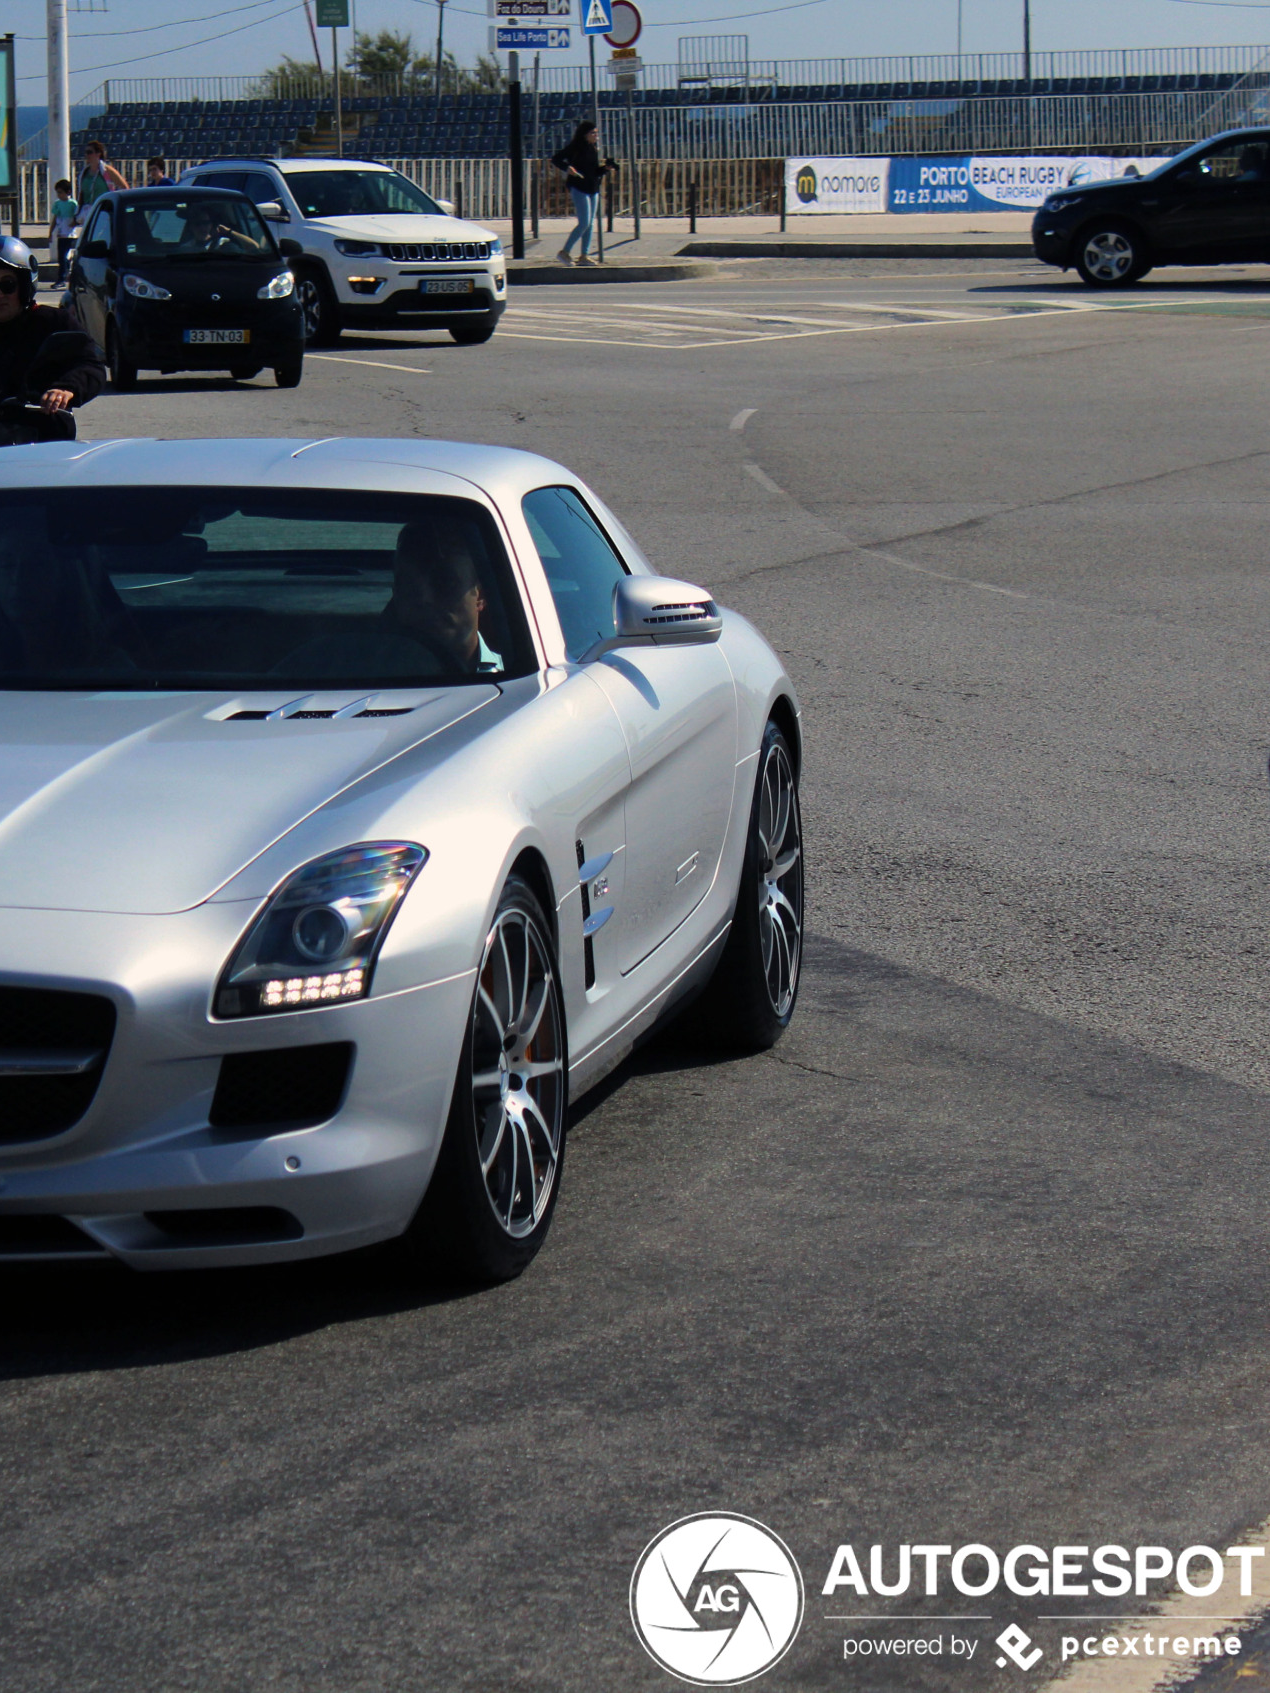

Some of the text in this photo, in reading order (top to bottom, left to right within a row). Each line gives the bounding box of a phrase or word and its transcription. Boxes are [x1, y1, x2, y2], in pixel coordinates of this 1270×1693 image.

[497, 4, 545, 14] Foz do Douro
[498, 32, 547, 42] Sea Life Porto
[920, 166, 1065, 186] PORTO BEACH RUGBY
[821, 176, 880, 193] nomore
[894, 189, 968, 204] 22 E 23 JUNHO
[996, 186, 1042, 199] EUROPEAN
